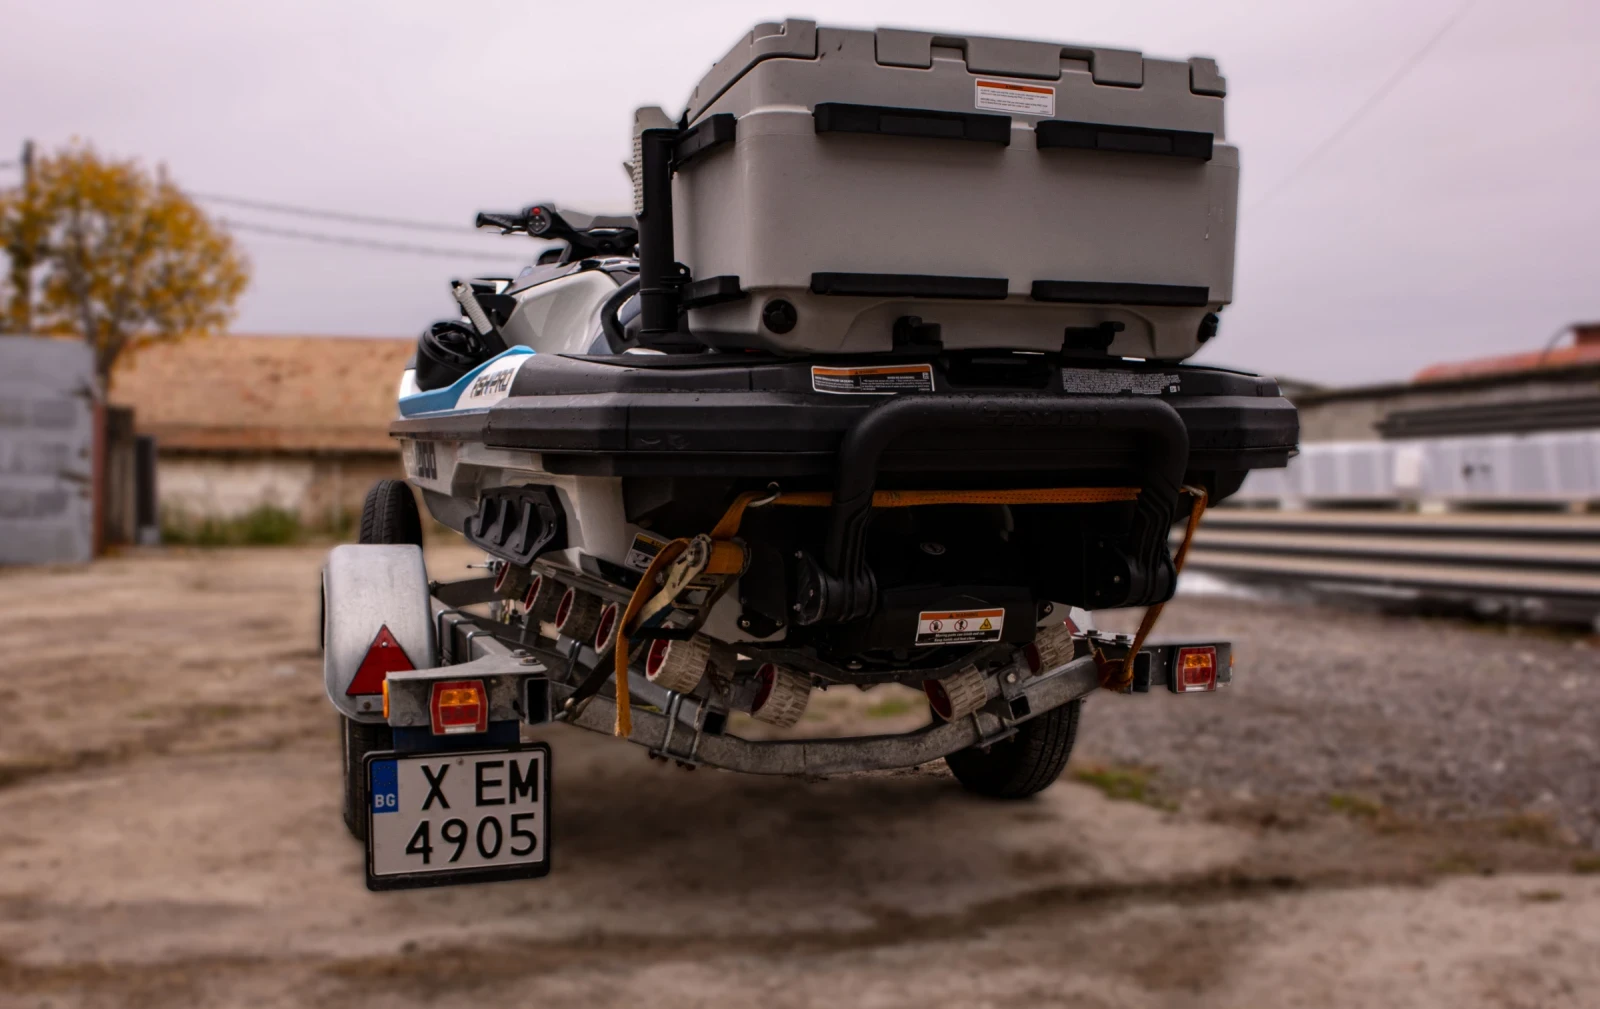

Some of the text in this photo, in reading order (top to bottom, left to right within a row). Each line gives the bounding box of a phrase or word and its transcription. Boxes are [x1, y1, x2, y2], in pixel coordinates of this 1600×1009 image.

[375, 793, 396, 808] BG
[421, 758, 539, 811] X EM
[405, 812, 537, 864] 4905
